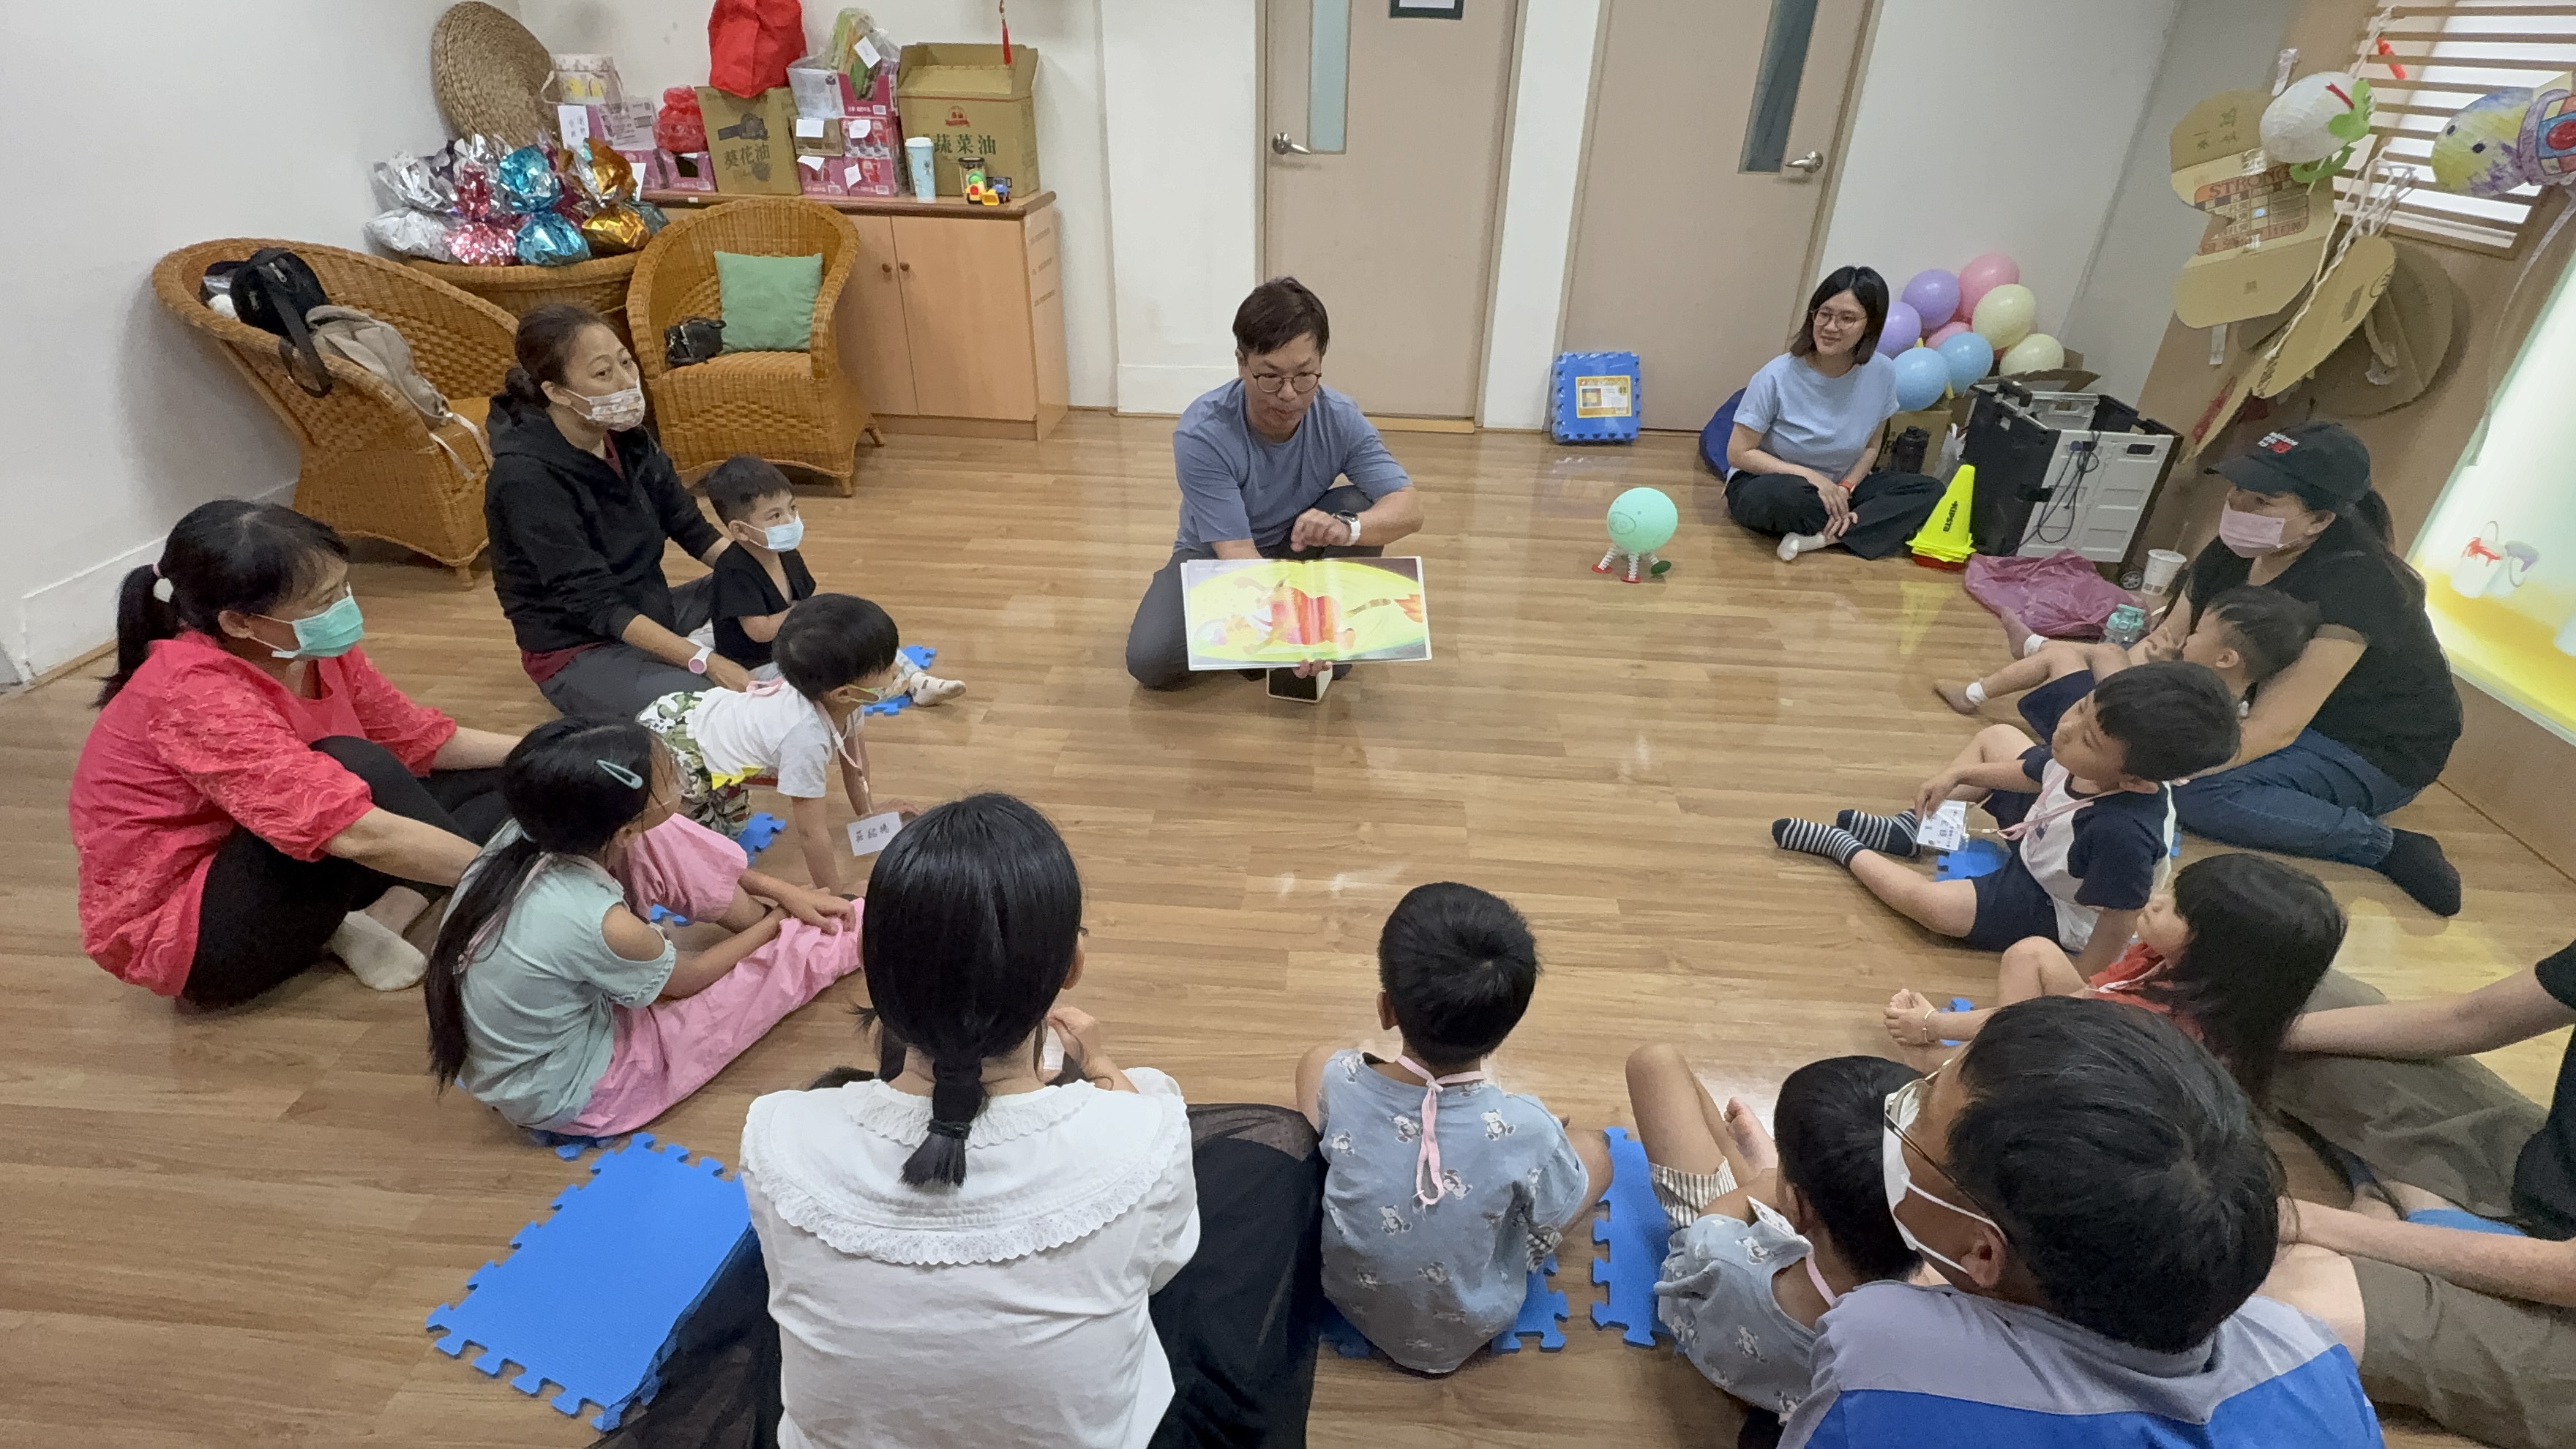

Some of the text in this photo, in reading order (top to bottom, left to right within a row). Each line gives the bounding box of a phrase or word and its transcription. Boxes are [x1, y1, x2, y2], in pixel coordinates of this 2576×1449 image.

[921, 132, 997, 155] 蔬菜油
[724, 143, 771, 171] 葵花油
